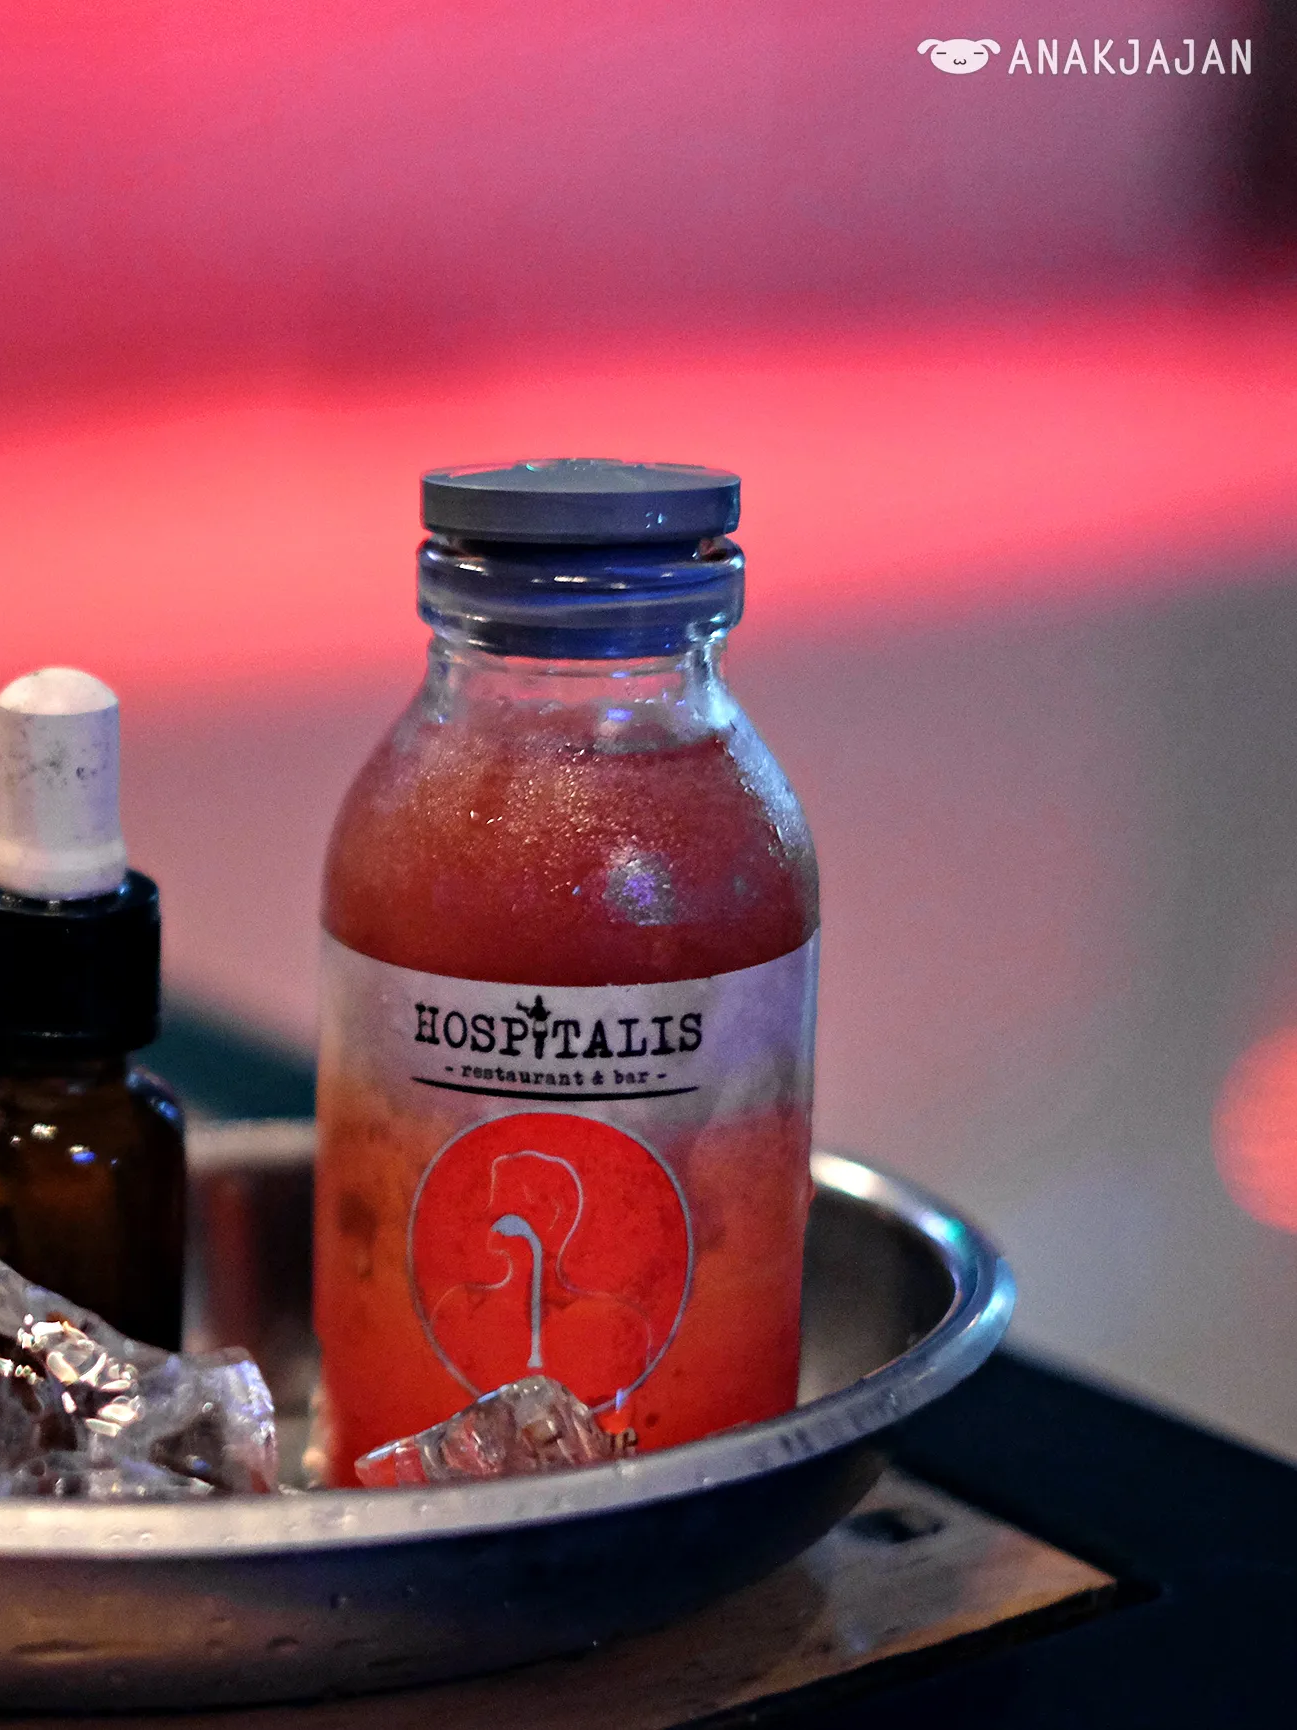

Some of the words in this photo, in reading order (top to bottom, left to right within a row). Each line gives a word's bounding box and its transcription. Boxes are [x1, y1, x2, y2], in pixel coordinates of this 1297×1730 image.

[414, 995, 703, 1059] HOSPITALIS
[462, 1064, 584, 1086] restaurant
[613, 1069, 650, 1085] bar
